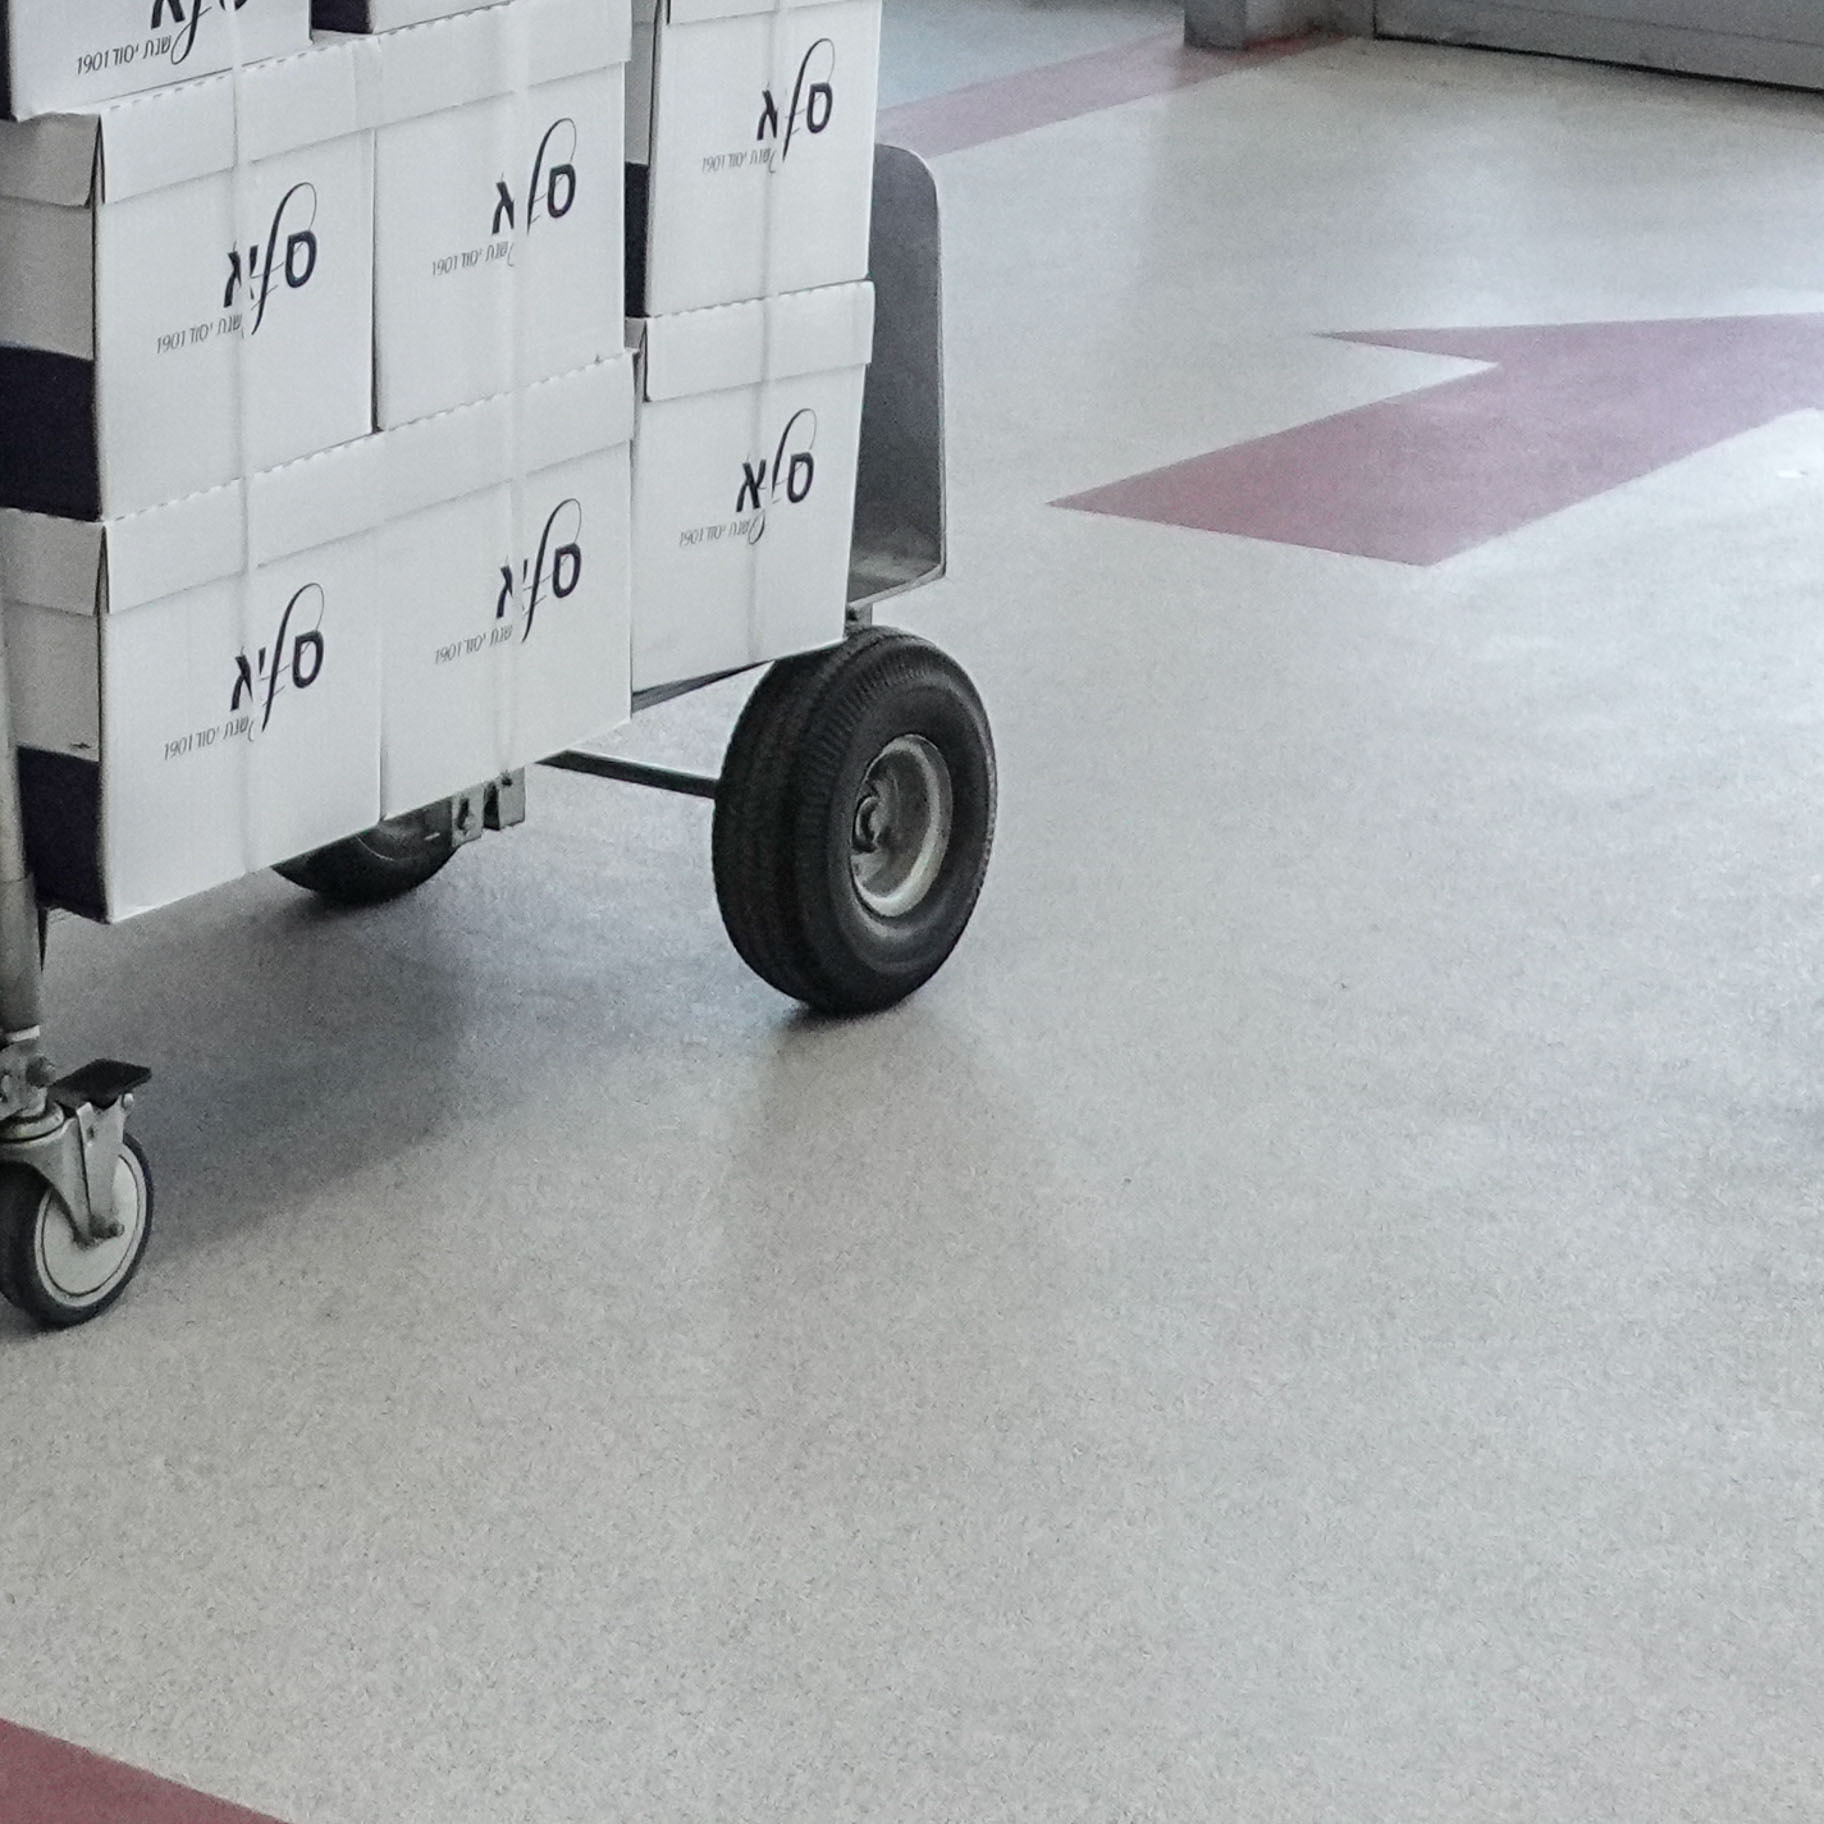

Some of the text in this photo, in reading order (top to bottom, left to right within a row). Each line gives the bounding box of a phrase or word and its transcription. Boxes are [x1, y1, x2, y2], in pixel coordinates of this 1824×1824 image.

[77, 35, 172, 75] שנת יסוד 1901
[156, 330, 185, 354] 1901
[163, 734, 194, 761] 1901
